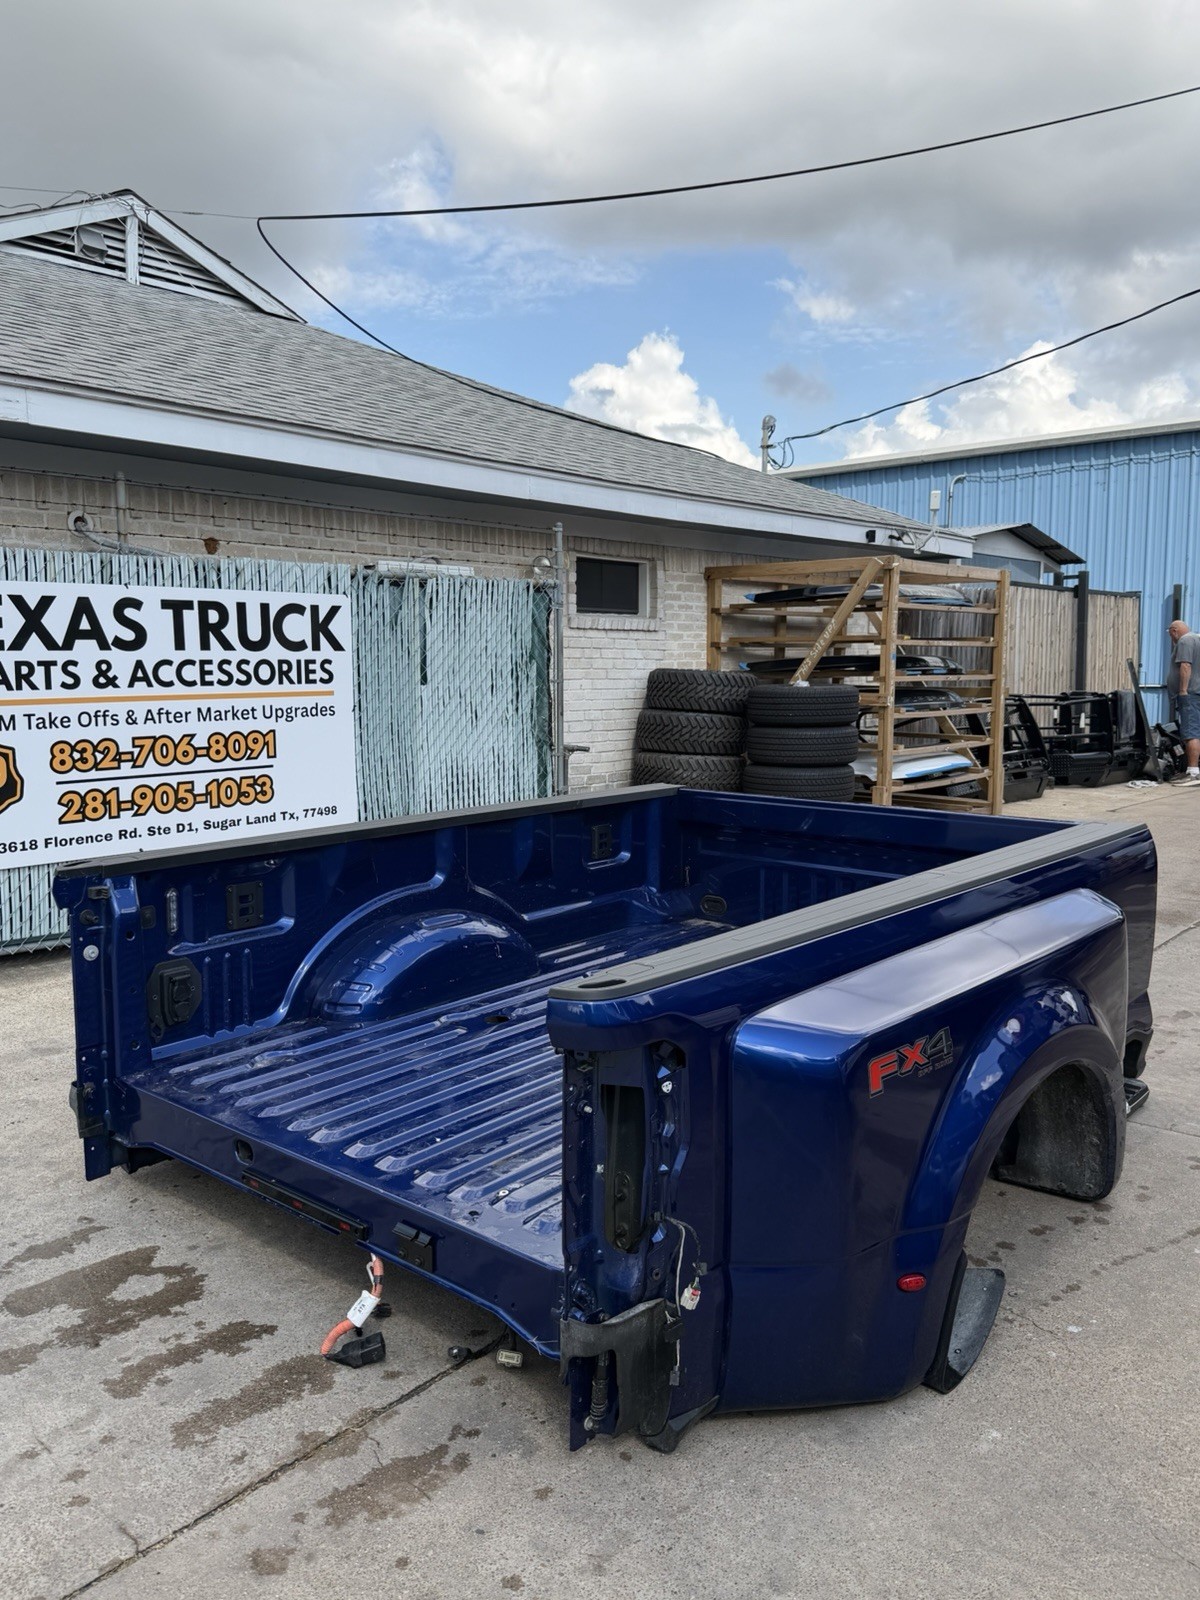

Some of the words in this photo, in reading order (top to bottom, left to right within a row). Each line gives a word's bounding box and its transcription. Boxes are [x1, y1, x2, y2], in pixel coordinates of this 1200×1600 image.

[0, 594, 148, 651] XAS
[161, 599, 346, 652] TRUCK
[92, 659, 120, 689] &
[127, 659, 335, 688] ACCESSORIES
[23, 712, 71, 731] Take
[77, 710, 120, 728] Offs
[125, 709, 138, 725] &
[143, 707, 192, 725] After
[197, 705, 258, 722] Market
[262, 702, 336, 723] Upgrades
[50, 730, 277, 774] 832-706-8091
[58, 774, 274, 825] 281-905-1053
[44, 831, 113, 848] Florence
[118, 827, 142, 840] Rd.
[147, 825, 171, 837] Ste
[176, 822, 199, 833] D1,
[203, 818, 242, 831] Sugar
[246, 812, 276, 825] Land
[280, 811, 299, 821] Tx,
[303, 805, 338, 818] 77498
[867, 1026, 953, 1099] FX4
